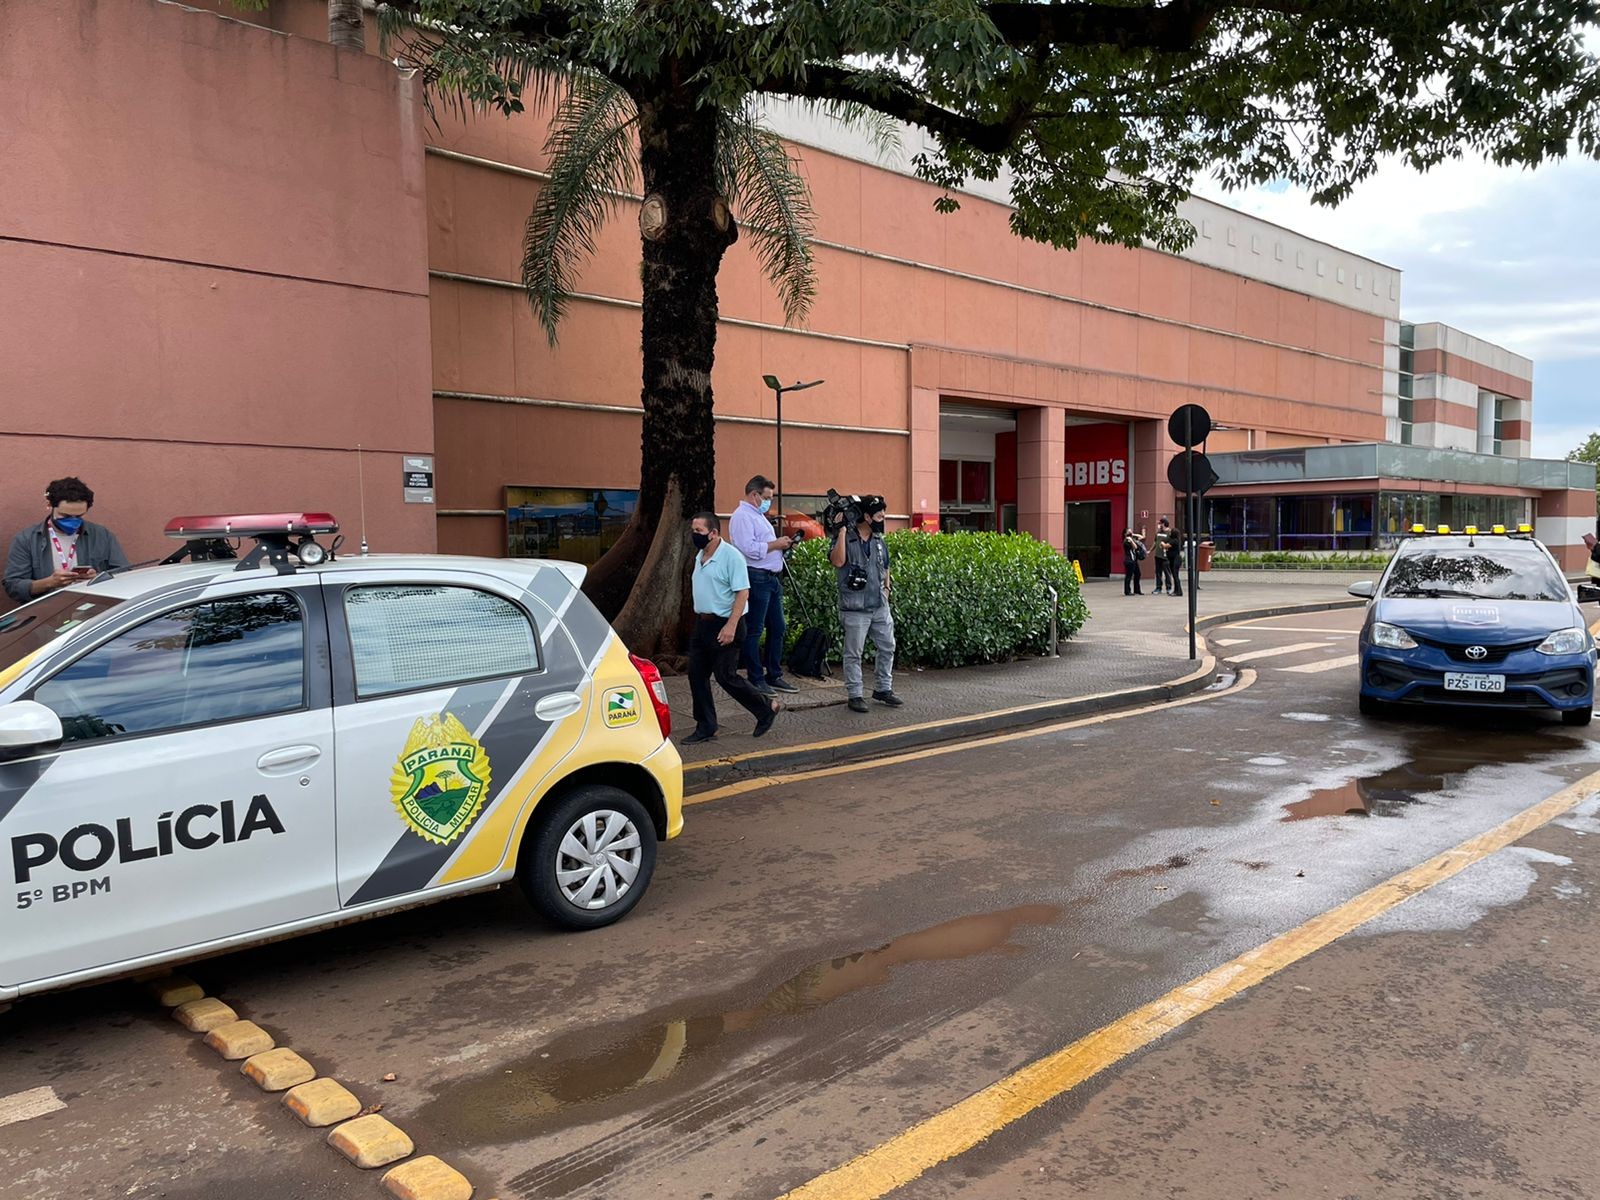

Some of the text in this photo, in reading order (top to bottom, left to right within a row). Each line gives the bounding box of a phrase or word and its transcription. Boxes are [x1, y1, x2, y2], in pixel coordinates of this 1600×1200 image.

[406, 746, 471, 771] PARANÁ
[406, 785, 479, 832] POLICIA MILITAR
[10, 794, 286, 884] POLÍCIA
[52, 876, 111, 902] BPM
